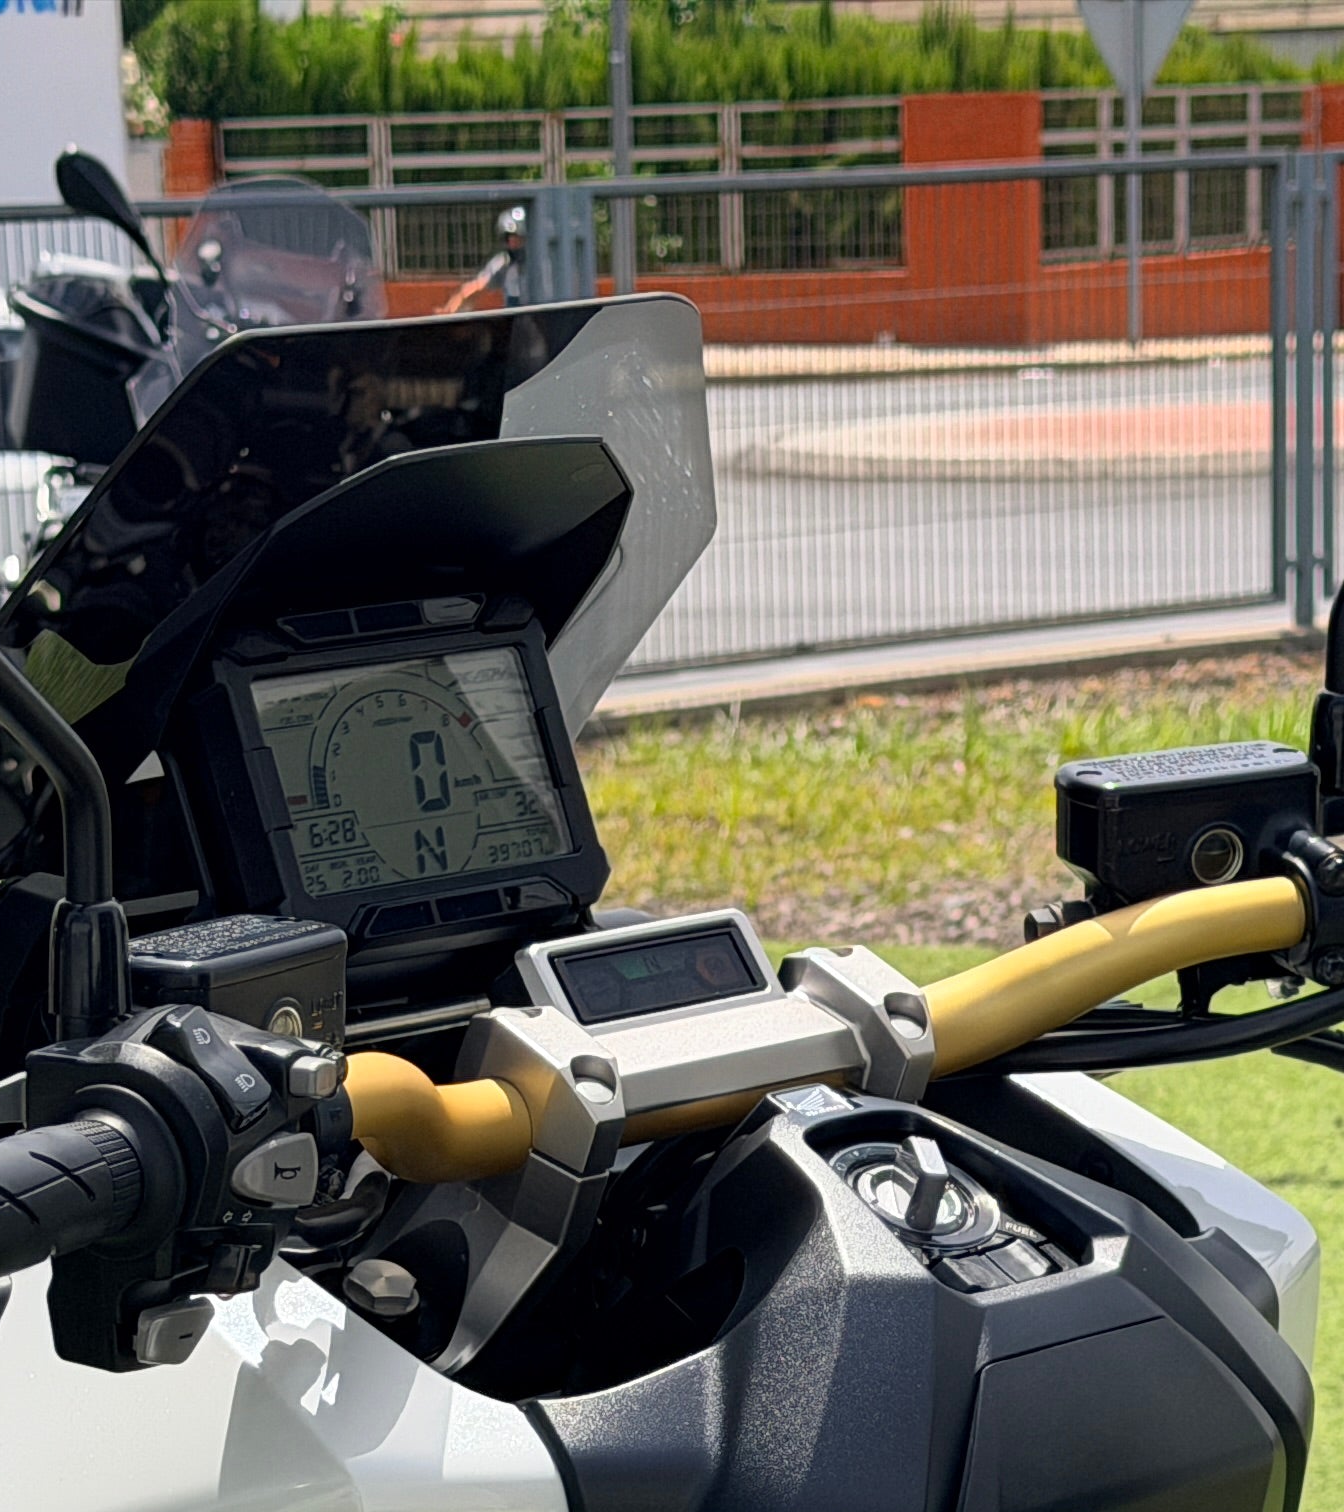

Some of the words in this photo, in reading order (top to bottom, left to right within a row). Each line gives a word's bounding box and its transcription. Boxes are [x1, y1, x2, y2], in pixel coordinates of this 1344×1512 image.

[375, 695, 384, 708] 5
[355, 705, 364, 716] 4
[342, 721, 351, 735] 3
[331, 743, 340, 756] 2
[409, 730, 451, 813] 0
[309, 818, 356, 848] 6:28
[414, 825, 449, 874] N
[1005, 1221, 1038, 1238] FUEL
